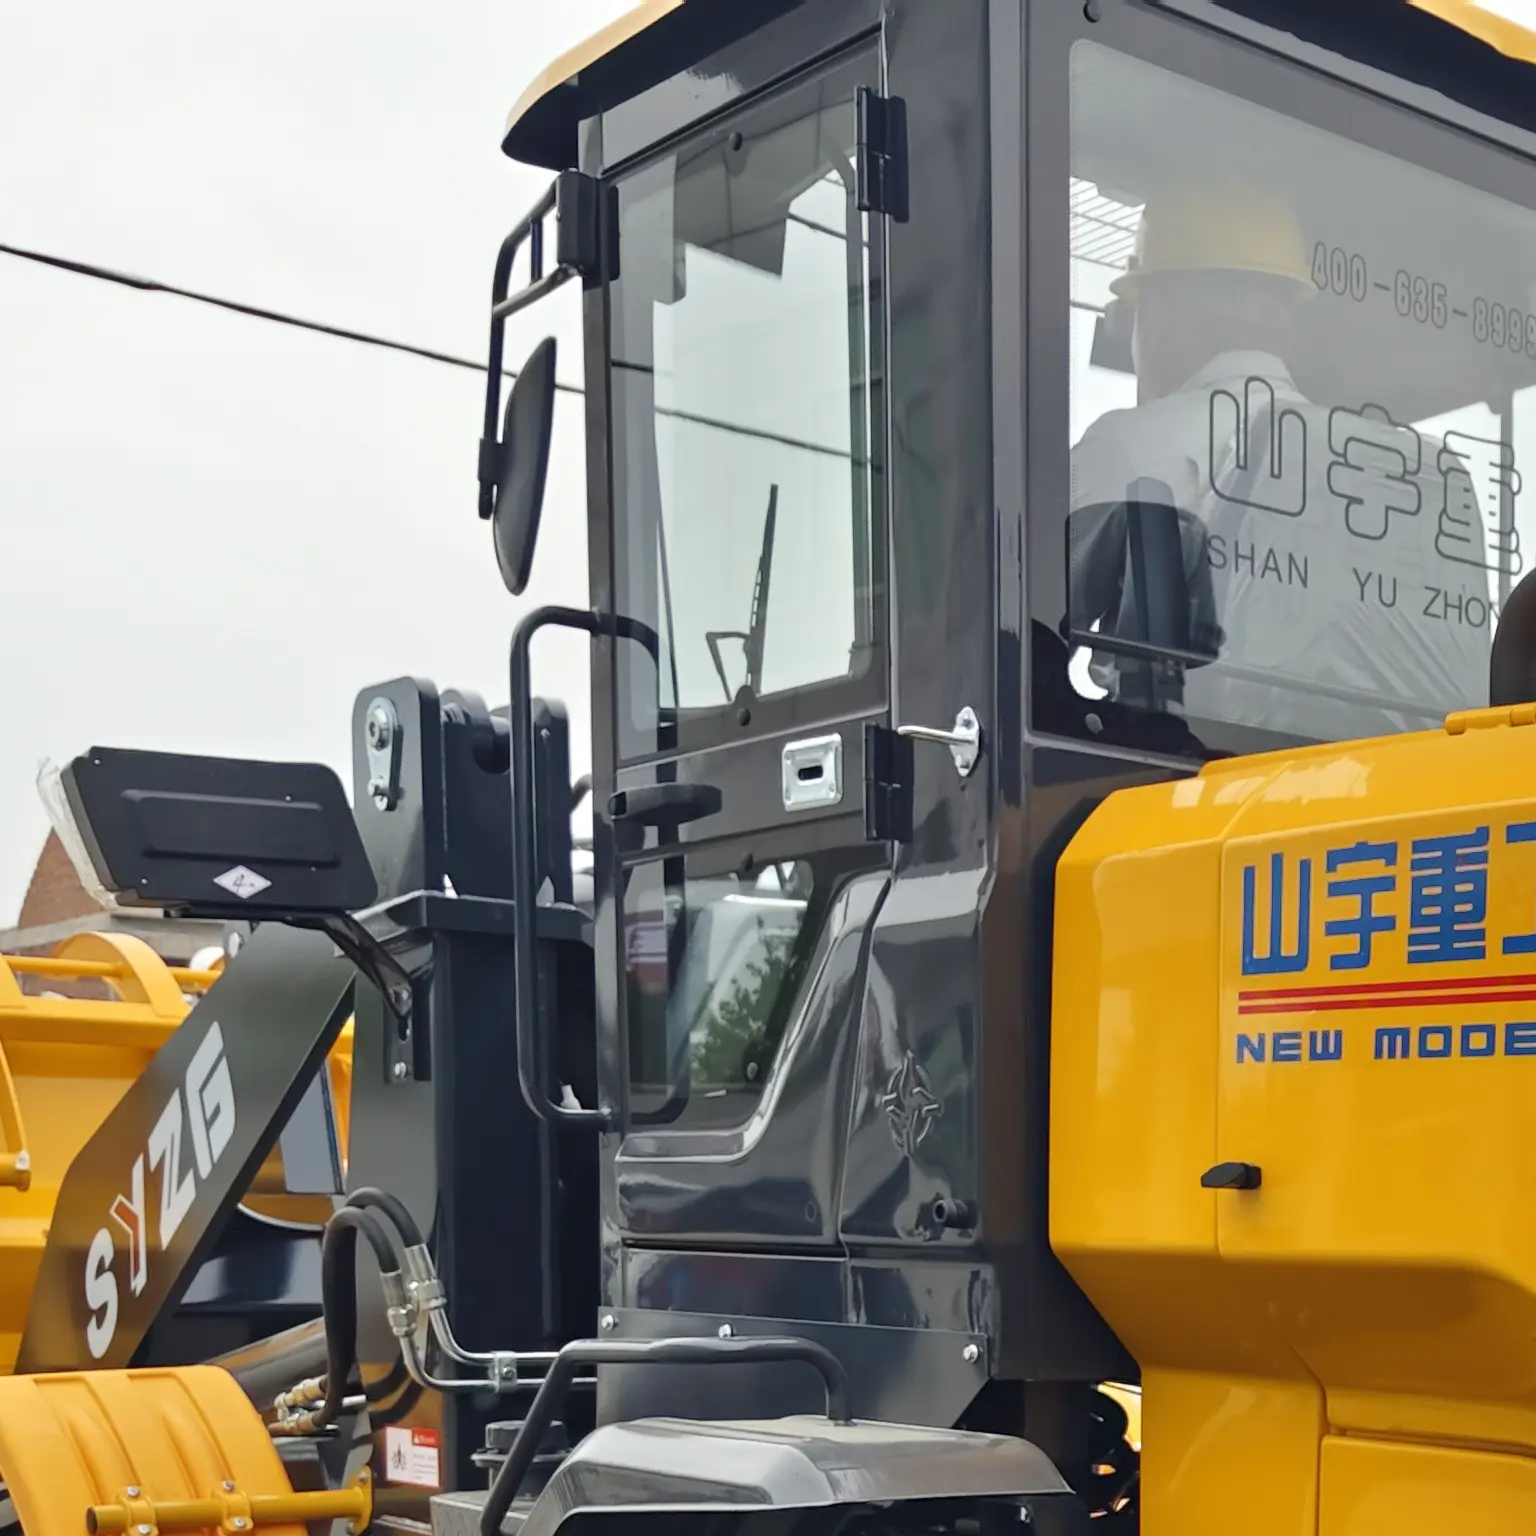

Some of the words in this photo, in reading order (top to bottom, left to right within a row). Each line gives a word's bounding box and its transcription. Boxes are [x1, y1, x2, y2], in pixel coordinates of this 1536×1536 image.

[1206, 534, 1309, 589] SHAN
[1352, 567, 1397, 608] YU
[1236, 1029, 1342, 1063] NEW
